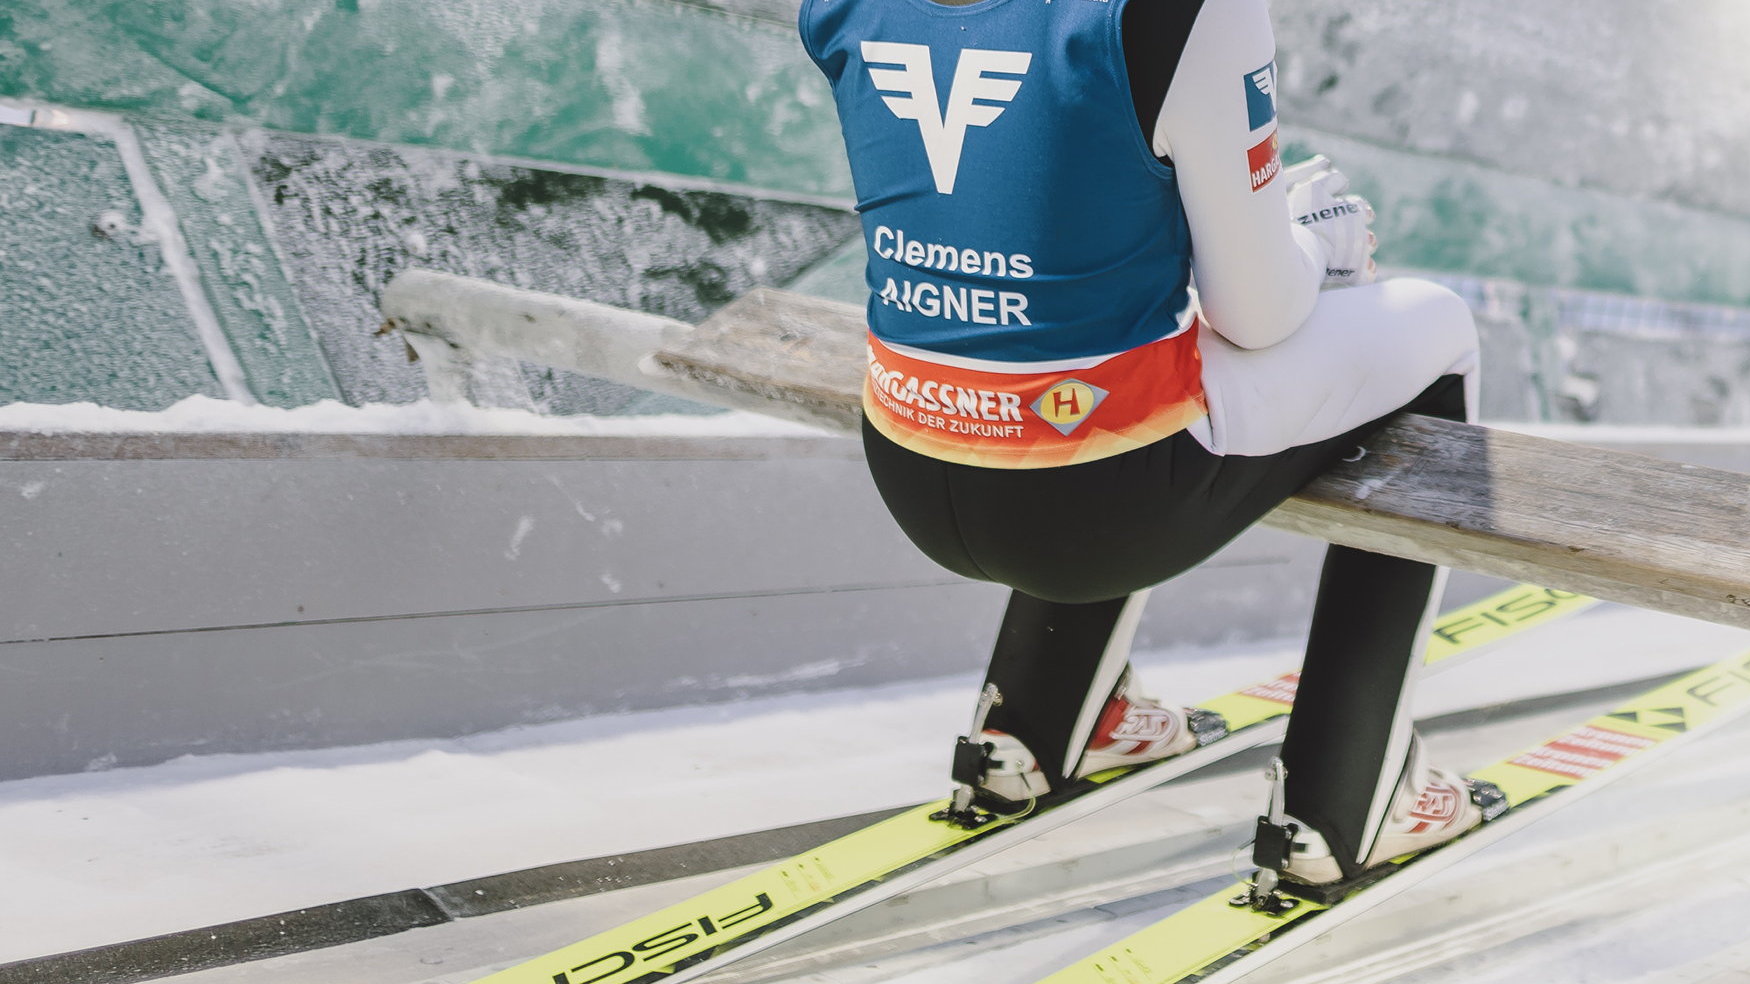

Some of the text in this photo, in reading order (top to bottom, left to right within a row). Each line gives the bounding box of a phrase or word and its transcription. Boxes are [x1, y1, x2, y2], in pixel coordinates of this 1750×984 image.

[873, 224, 1035, 279] Clemens
[880, 277, 1033, 326] AIGNER
[918, 410, 946, 431] DER
[949, 418, 1024, 438] ZUKUNFT
